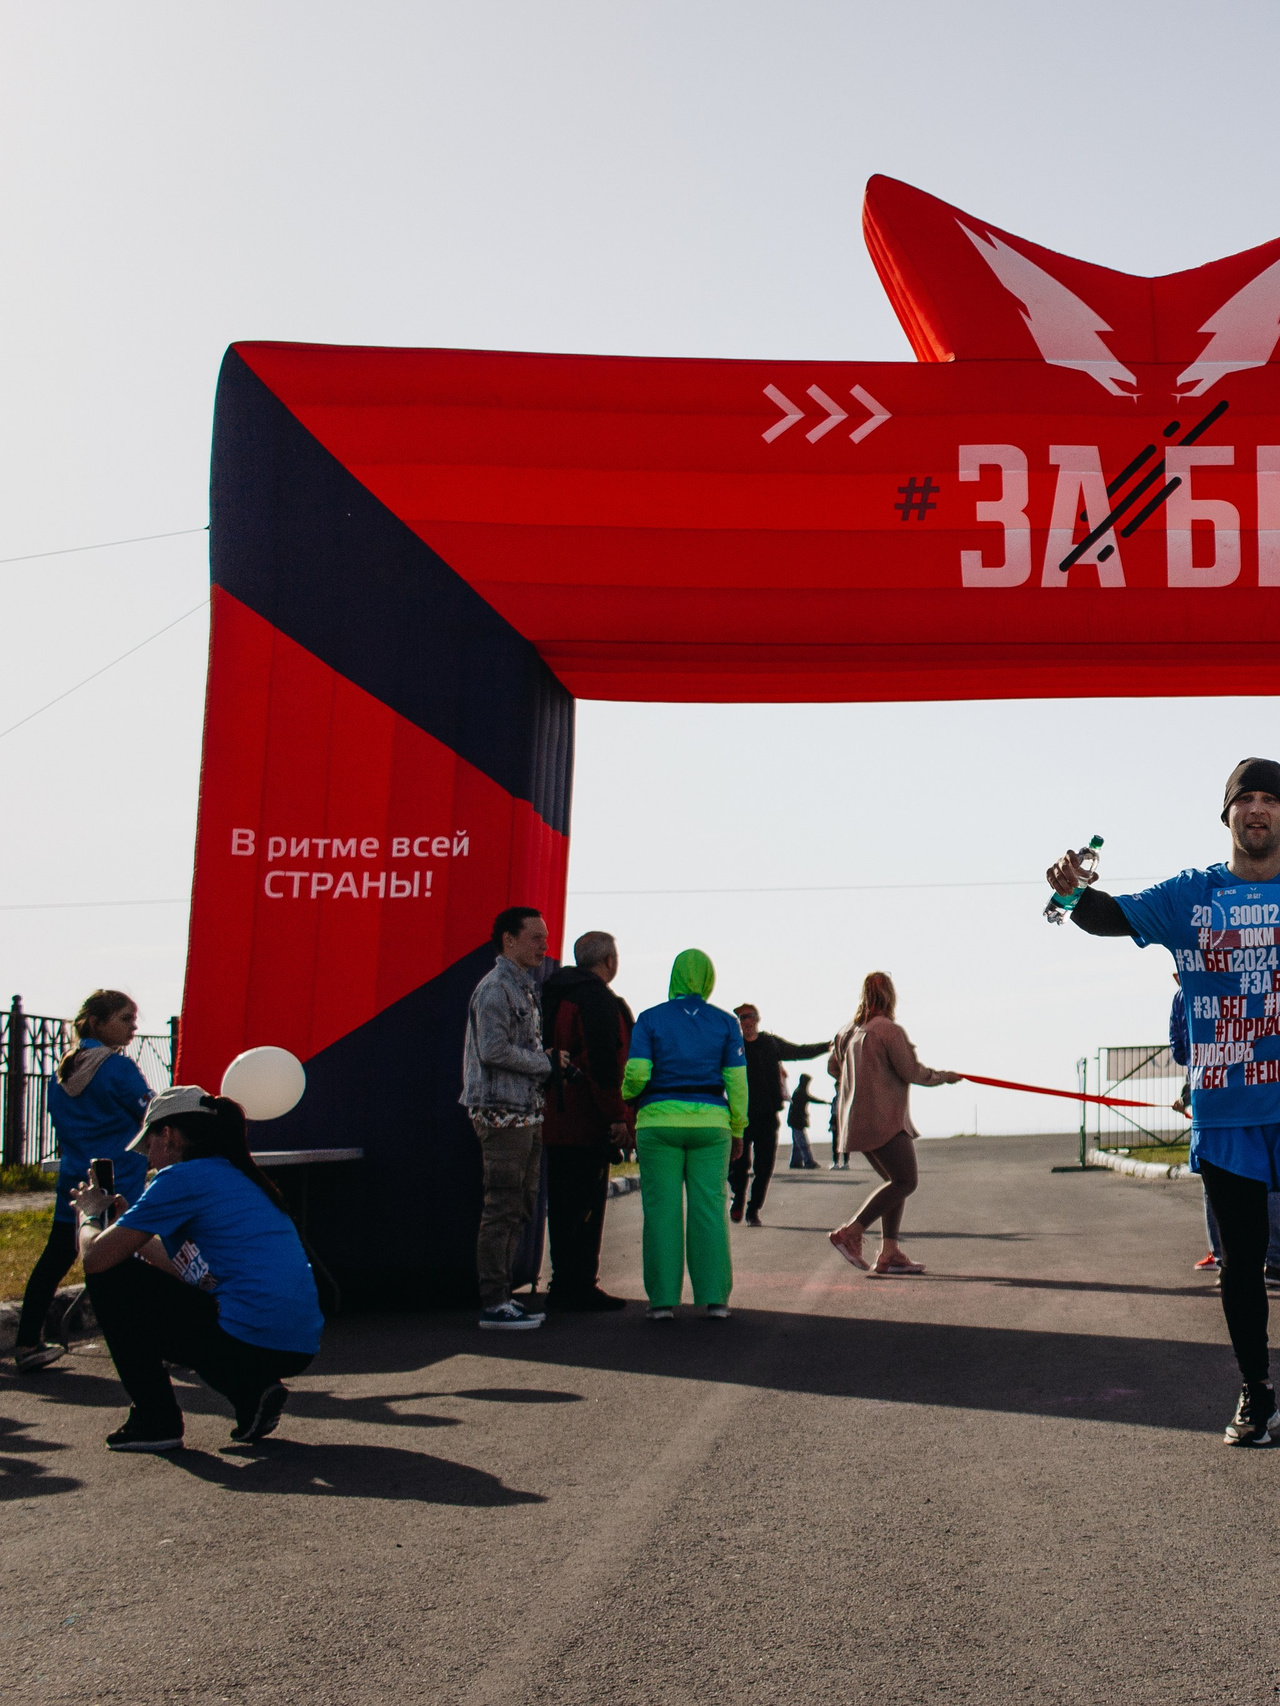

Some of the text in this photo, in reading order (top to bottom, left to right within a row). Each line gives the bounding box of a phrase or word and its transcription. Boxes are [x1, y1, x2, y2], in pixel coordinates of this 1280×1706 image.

[231, 828, 470, 862] В ритме всей
[264, 870, 433, 899] СТРАНЫ!
[1229, 903, 1280, 927] 30012
[1238, 927, 1275, 948] 10КМ
[1193, 996, 1248, 1020] #ЗАБЕГ
